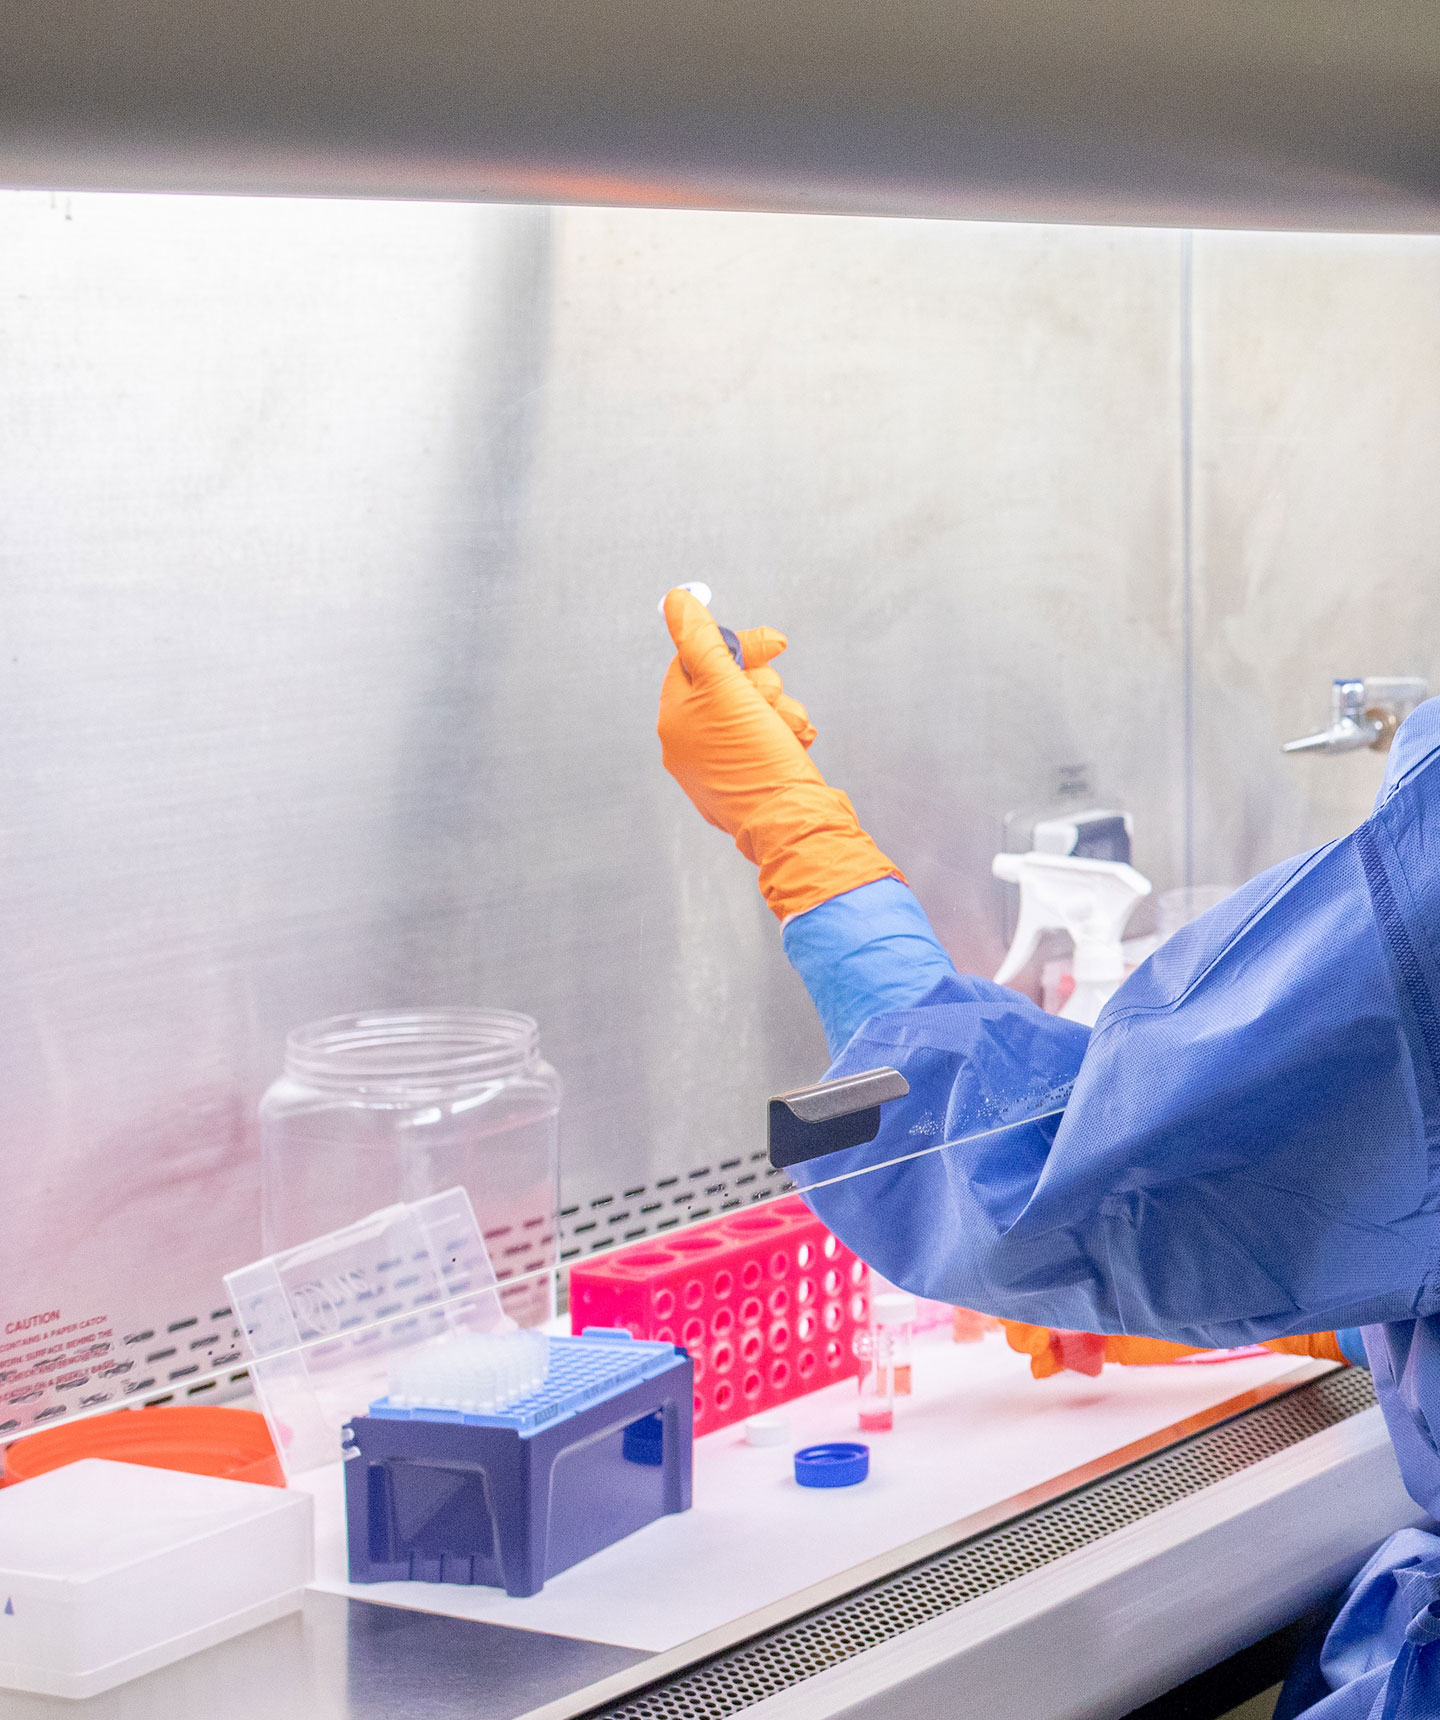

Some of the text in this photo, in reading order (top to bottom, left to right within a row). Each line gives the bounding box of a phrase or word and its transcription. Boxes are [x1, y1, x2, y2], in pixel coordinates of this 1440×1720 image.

[5, 1310, 60, 1334] CAUTION
[51, 1323, 78, 1337] PAPER
[80, 1315, 108, 1329] CATCH
[26, 1343, 63, 1361] SURFACE
[66, 1333, 96, 1349] BEHIND
[98, 1328, 113, 1340] THE
